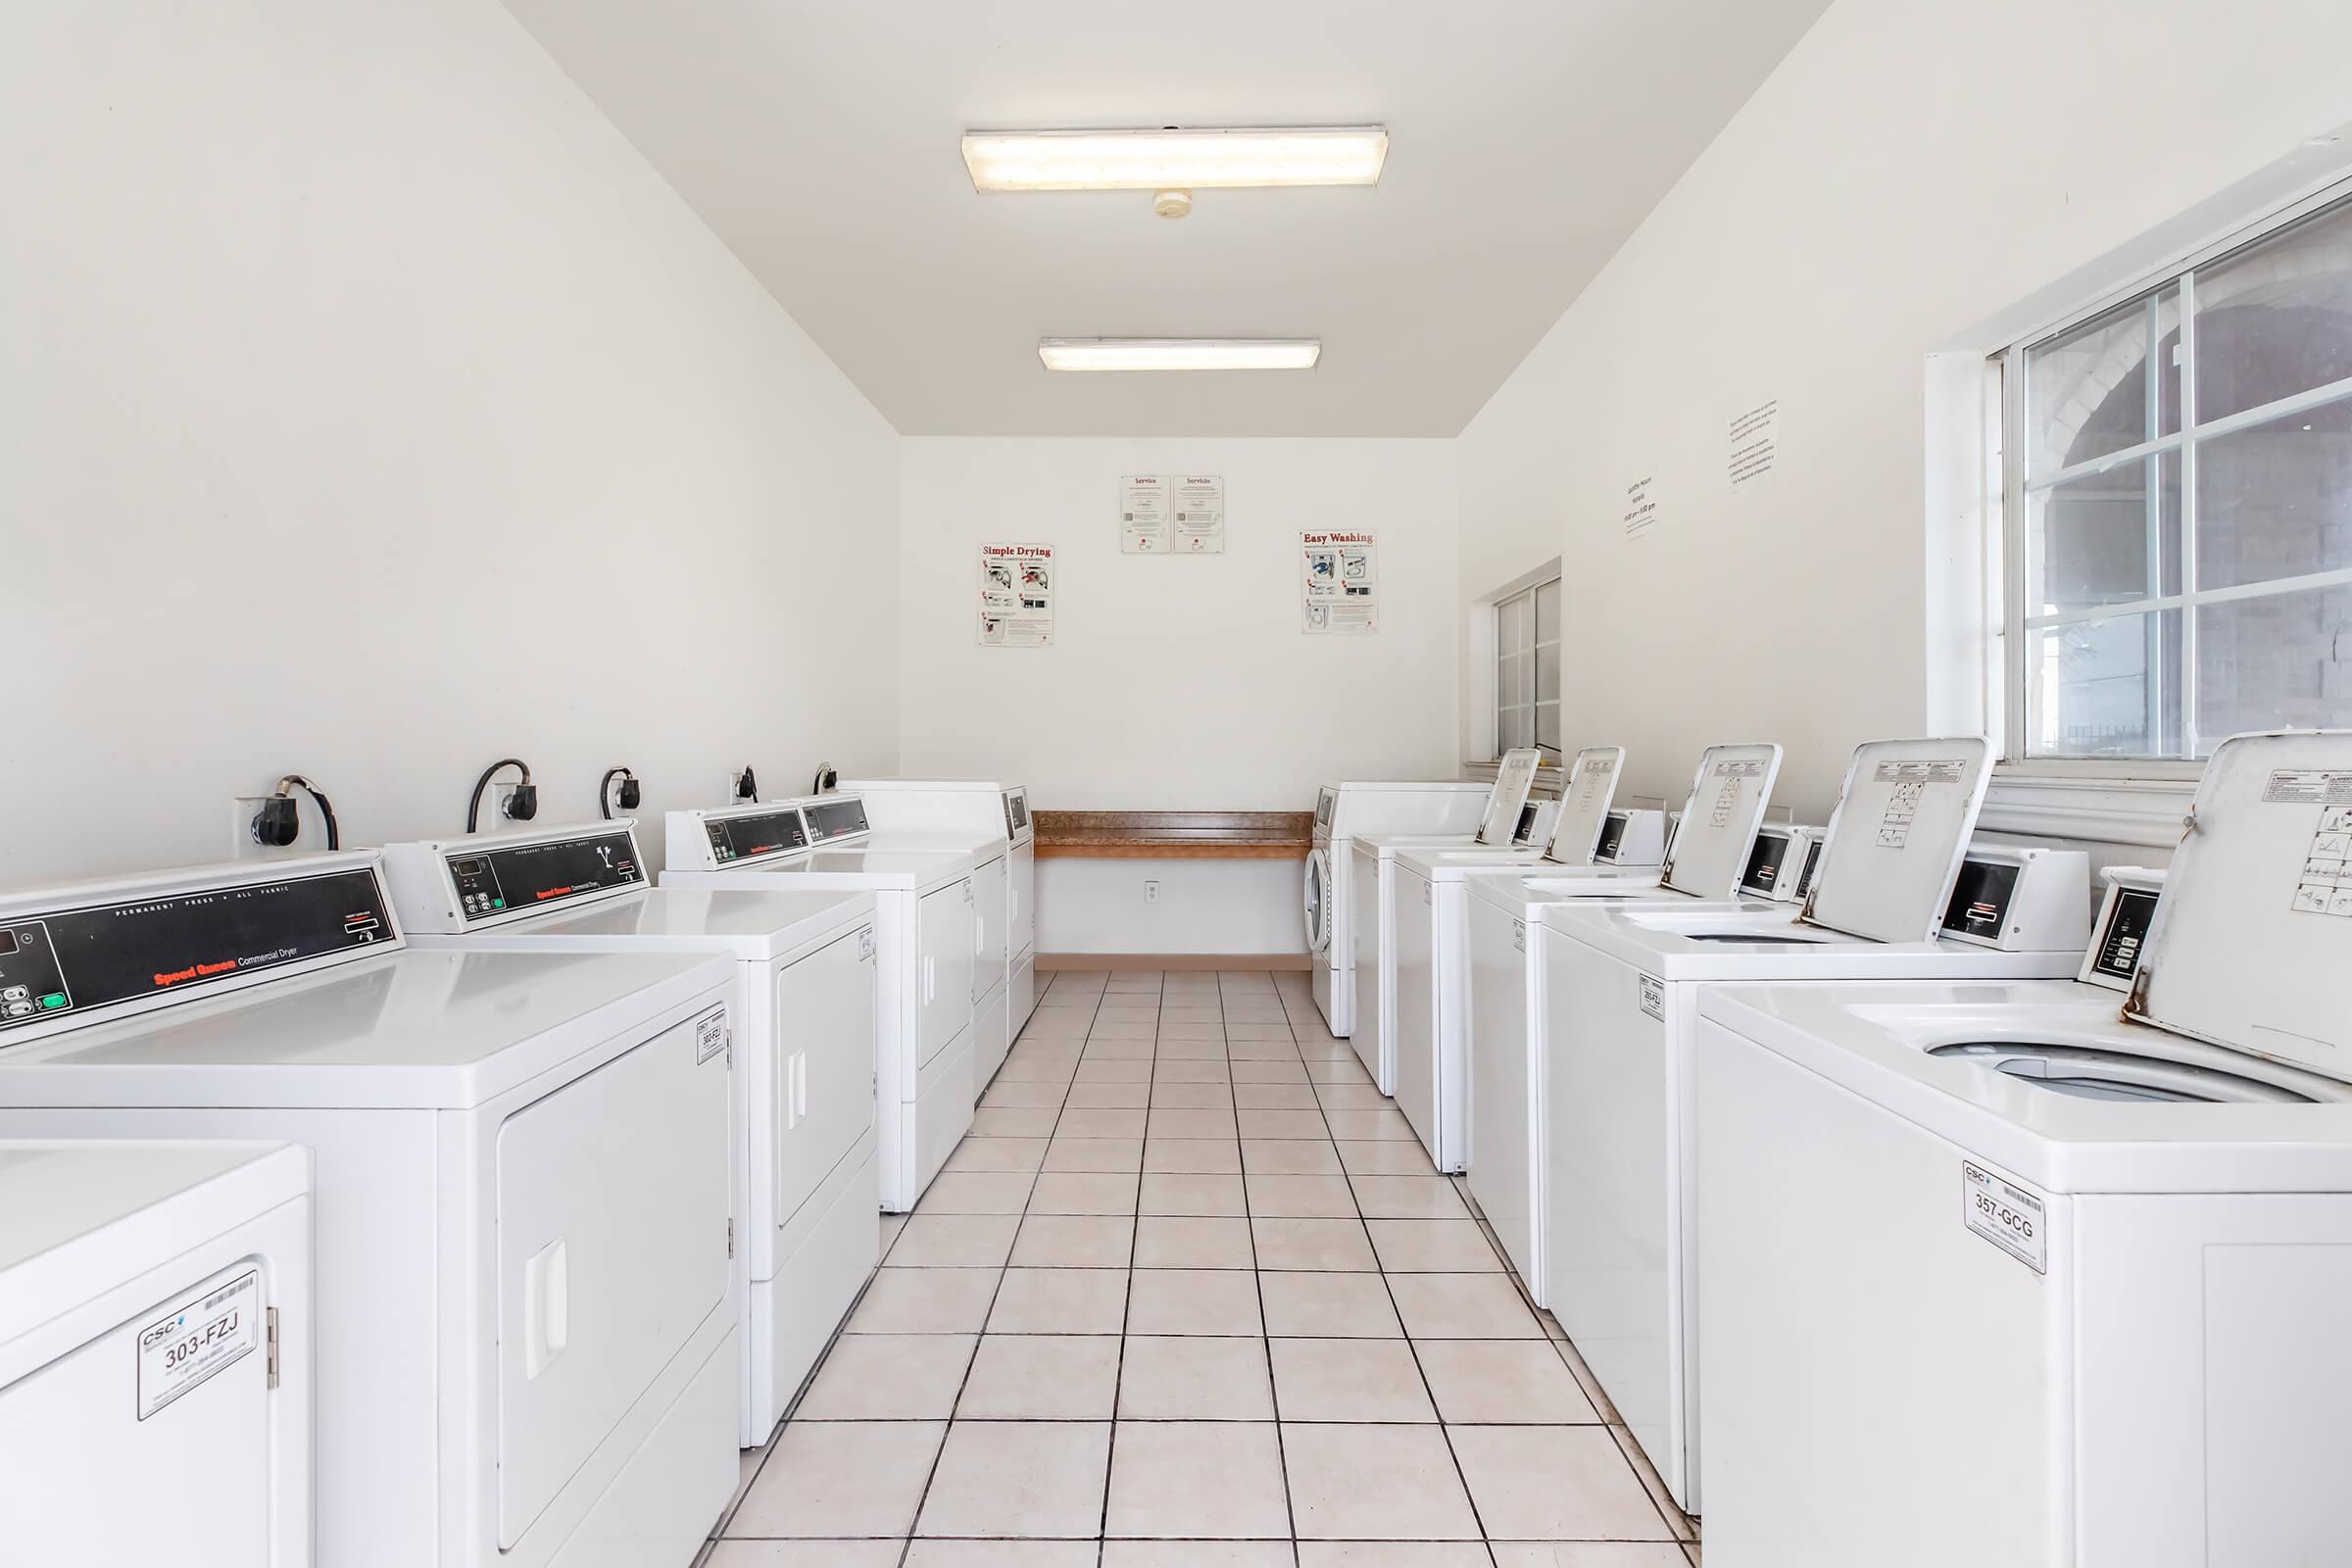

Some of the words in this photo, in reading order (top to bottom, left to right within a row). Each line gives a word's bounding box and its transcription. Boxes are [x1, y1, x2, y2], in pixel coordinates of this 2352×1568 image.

[982, 546, 1015, 558] Simple
[1016, 547, 1052, 559] Drying
[1303, 533, 1328, 545] Easy
[1329, 532, 1374, 544] Washing
[115, 902, 174, 917] PERMANENT
[184, 897, 214, 906] PRESS
[260, 885, 289, 895] FABRIC
[153, 965, 197, 986] Speed
[196, 958, 237, 976] Queen
[237, 950, 279, 967] Commercial
[278, 946, 299, 958] Dryer
[1966, 1166, 1984, 1182] CSC
[1976, 1194, 2033, 1237] 357-GCG
[143, 1321, 174, 1346] CSC
[166, 1312, 238, 1368] 303-FZJ
